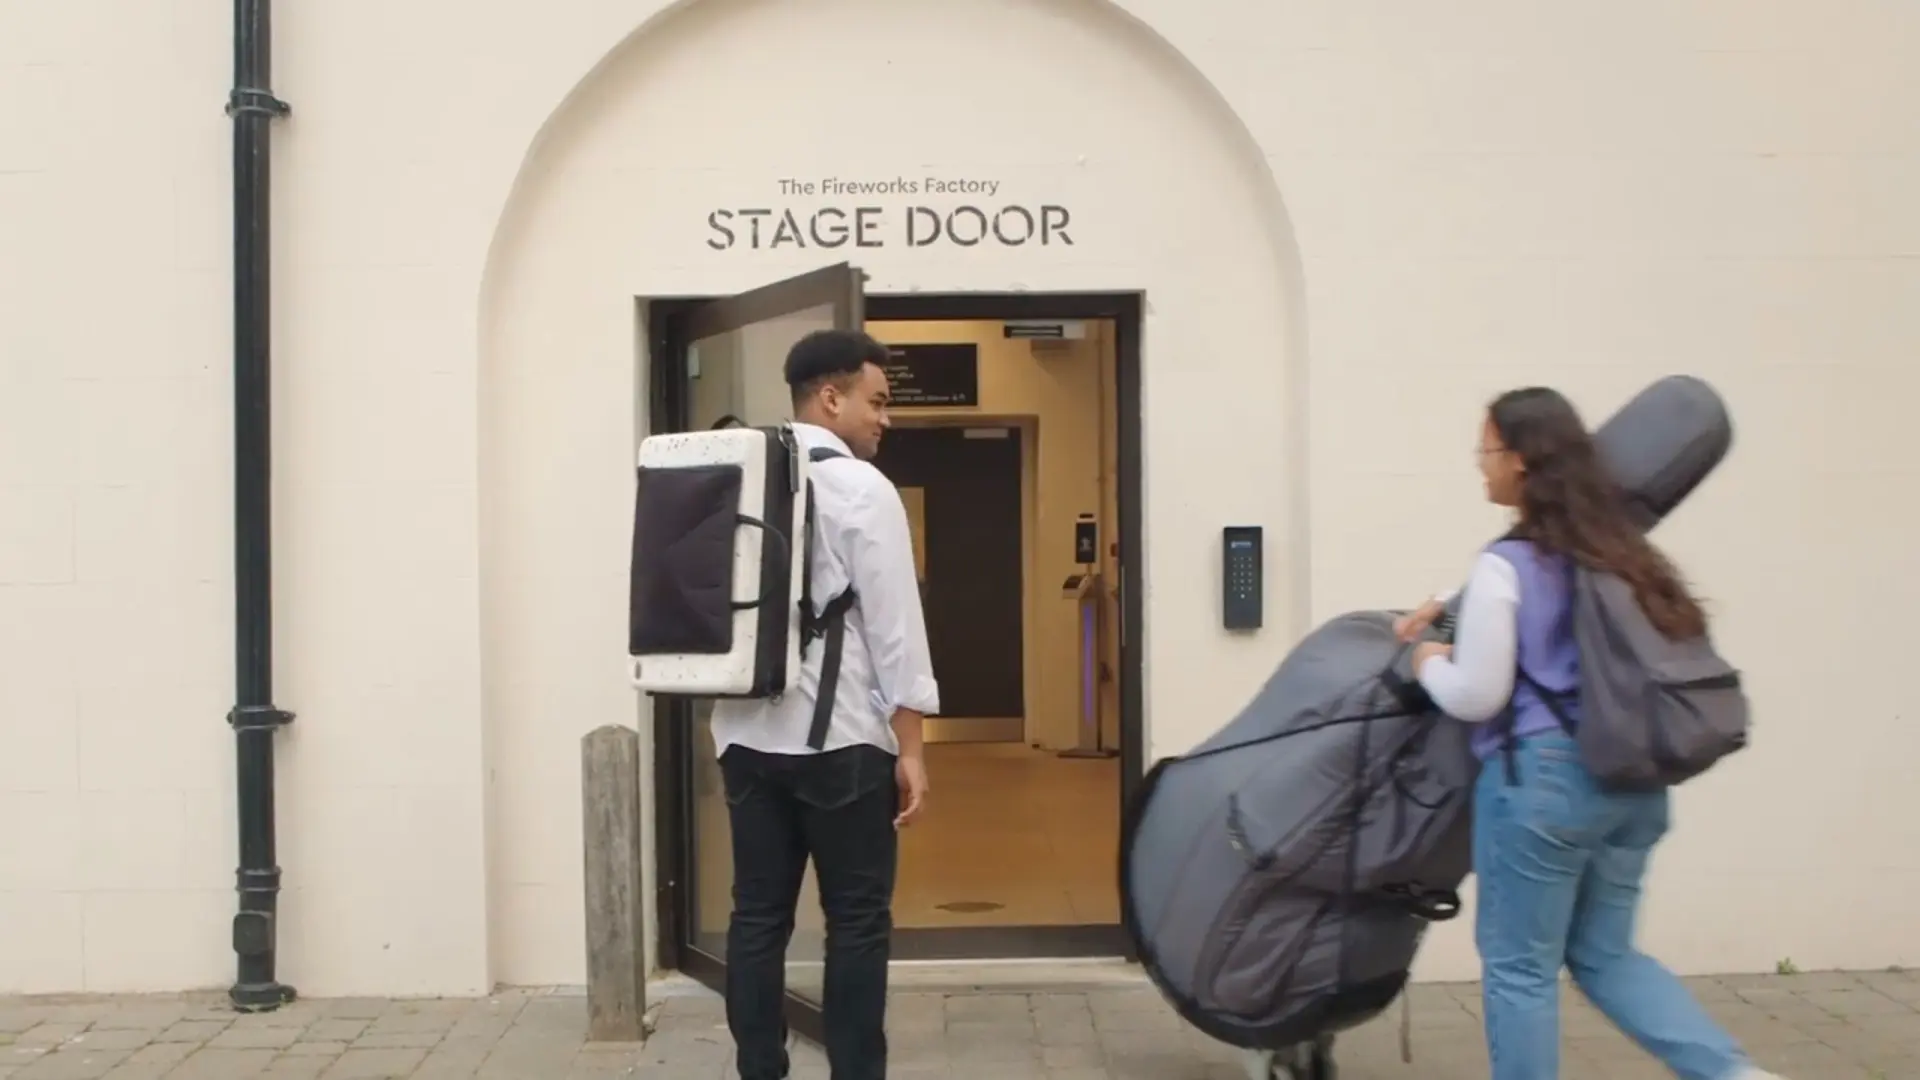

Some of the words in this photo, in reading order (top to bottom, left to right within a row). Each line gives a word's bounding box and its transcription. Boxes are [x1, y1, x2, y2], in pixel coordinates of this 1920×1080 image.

[778, 178, 815, 195] The
[822, 176, 918, 194] Fireworks
[925, 176, 1000, 197] Factory
[706, 206, 884, 250] STAGE
[906, 204, 1074, 247] DOOR
